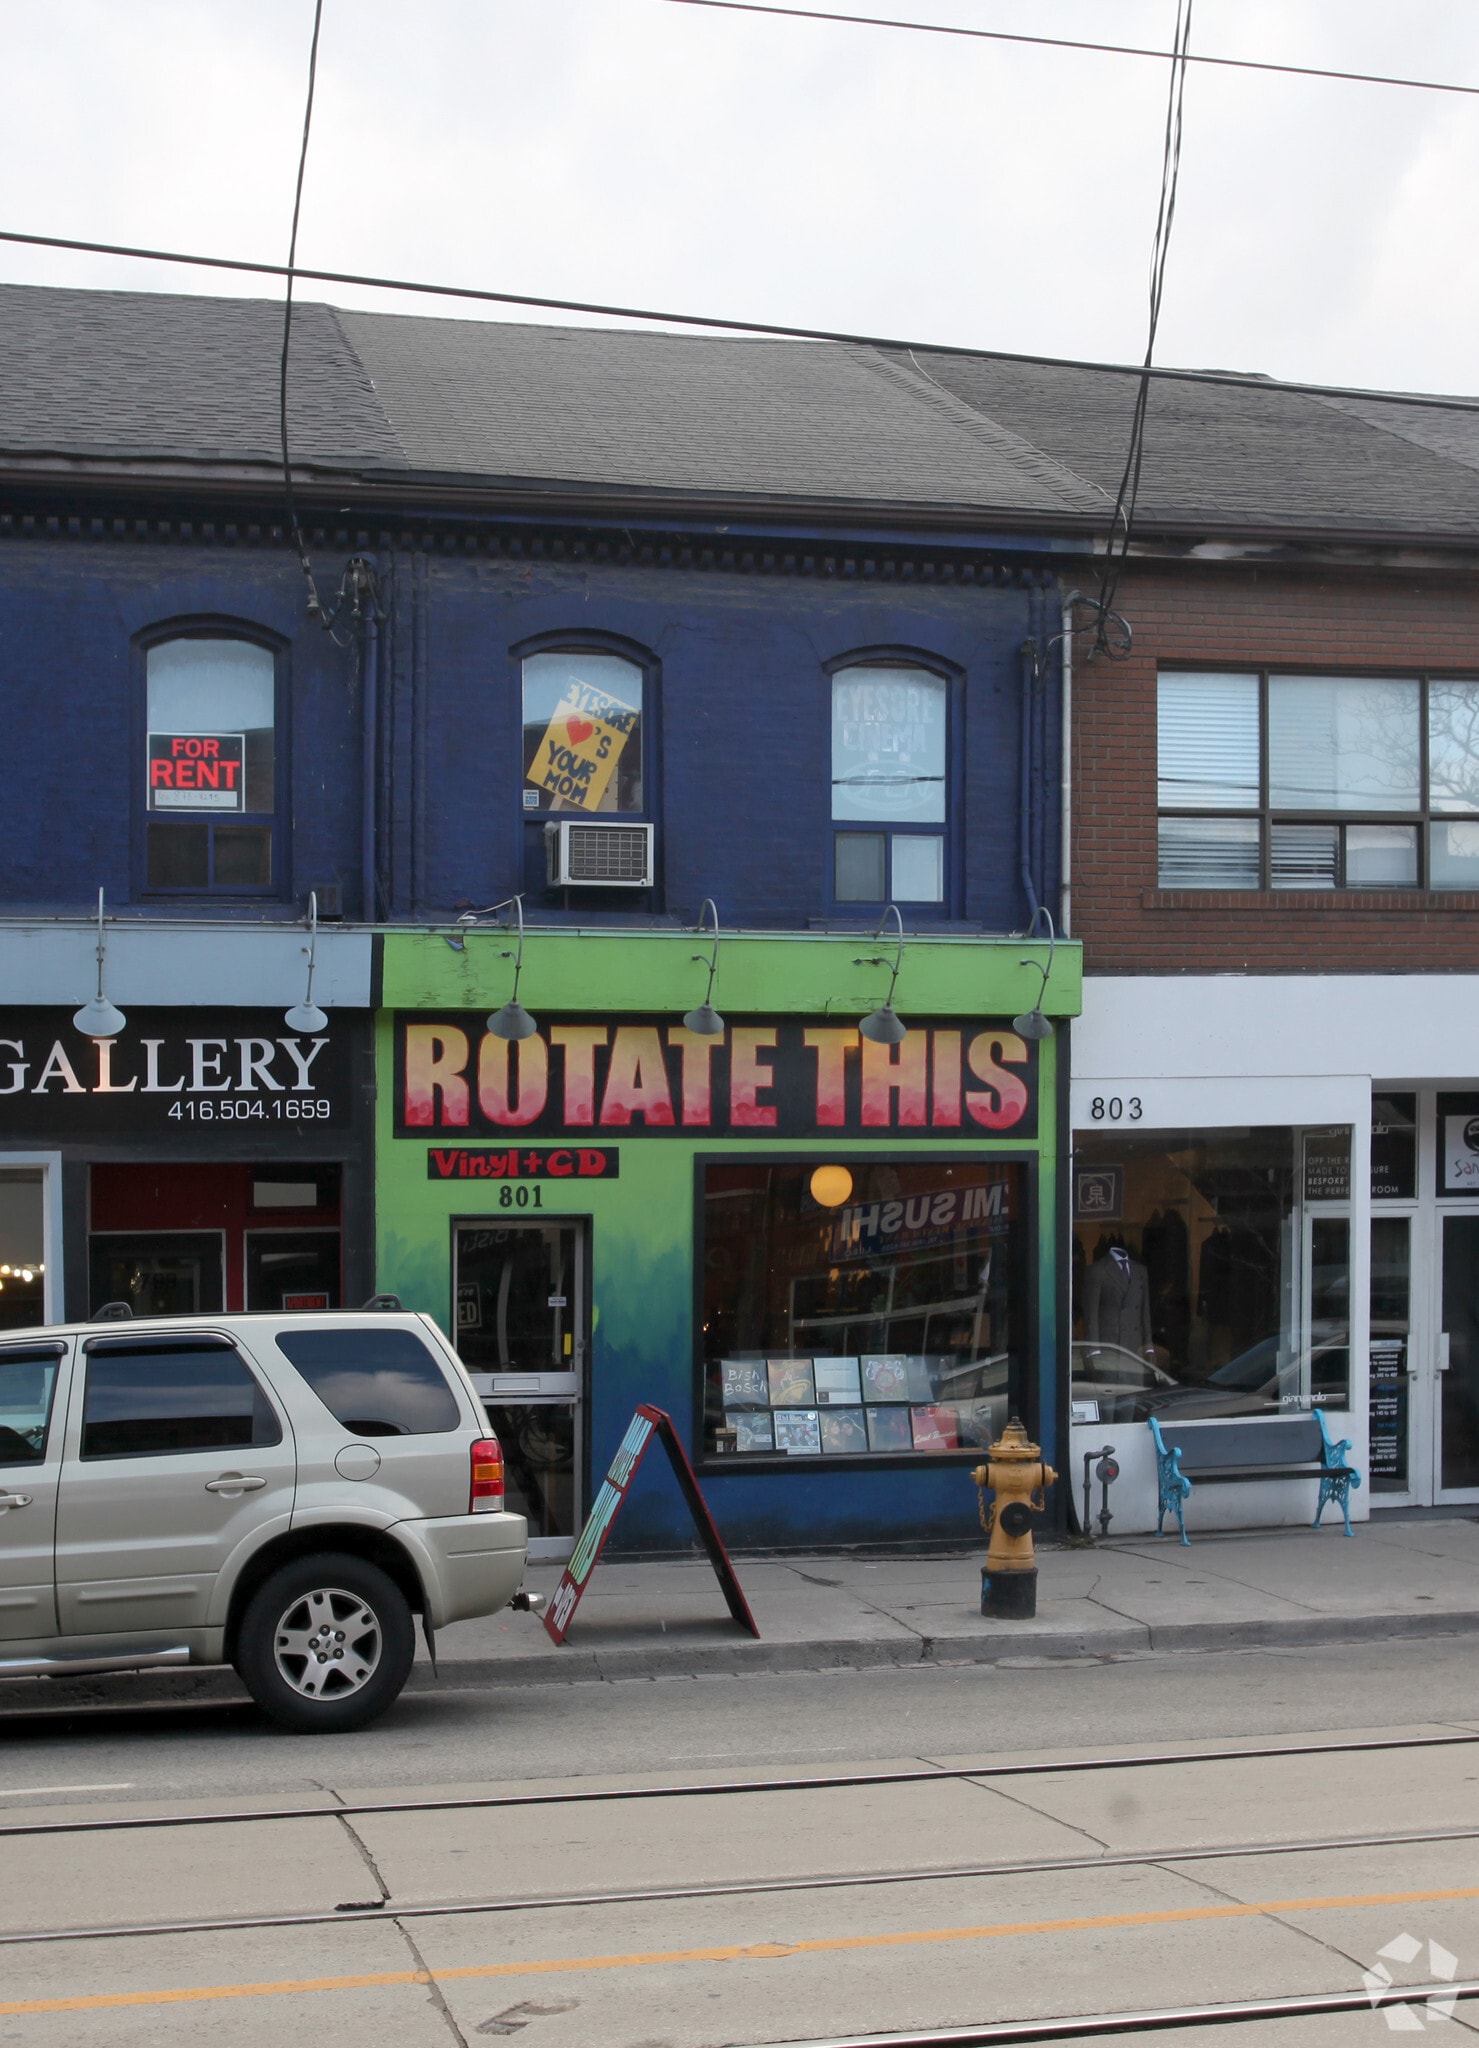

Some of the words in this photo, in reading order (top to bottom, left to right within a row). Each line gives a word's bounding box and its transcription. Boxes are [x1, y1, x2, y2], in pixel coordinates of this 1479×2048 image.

[837, 684, 934, 723] EYESORE
[171, 738, 220, 758] FOR
[843, 722, 926, 752] CINEMA
[151, 758, 241, 789] RENT
[547, 739, 597, 785] YOUR
[542, 769, 588, 805] MOM
[405, 1024, 778, 1127] ROTATE
[803, 1027, 1029, 1130] THIS
[168, 1099, 331, 1121] 416.504.1659
[1091, 1096, 1143, 1120] 803
[499, 1185, 543, 1208] 801
[1325, 1187, 1351, 1195] PERFE
[727, 1369, 760, 1381] Bish
